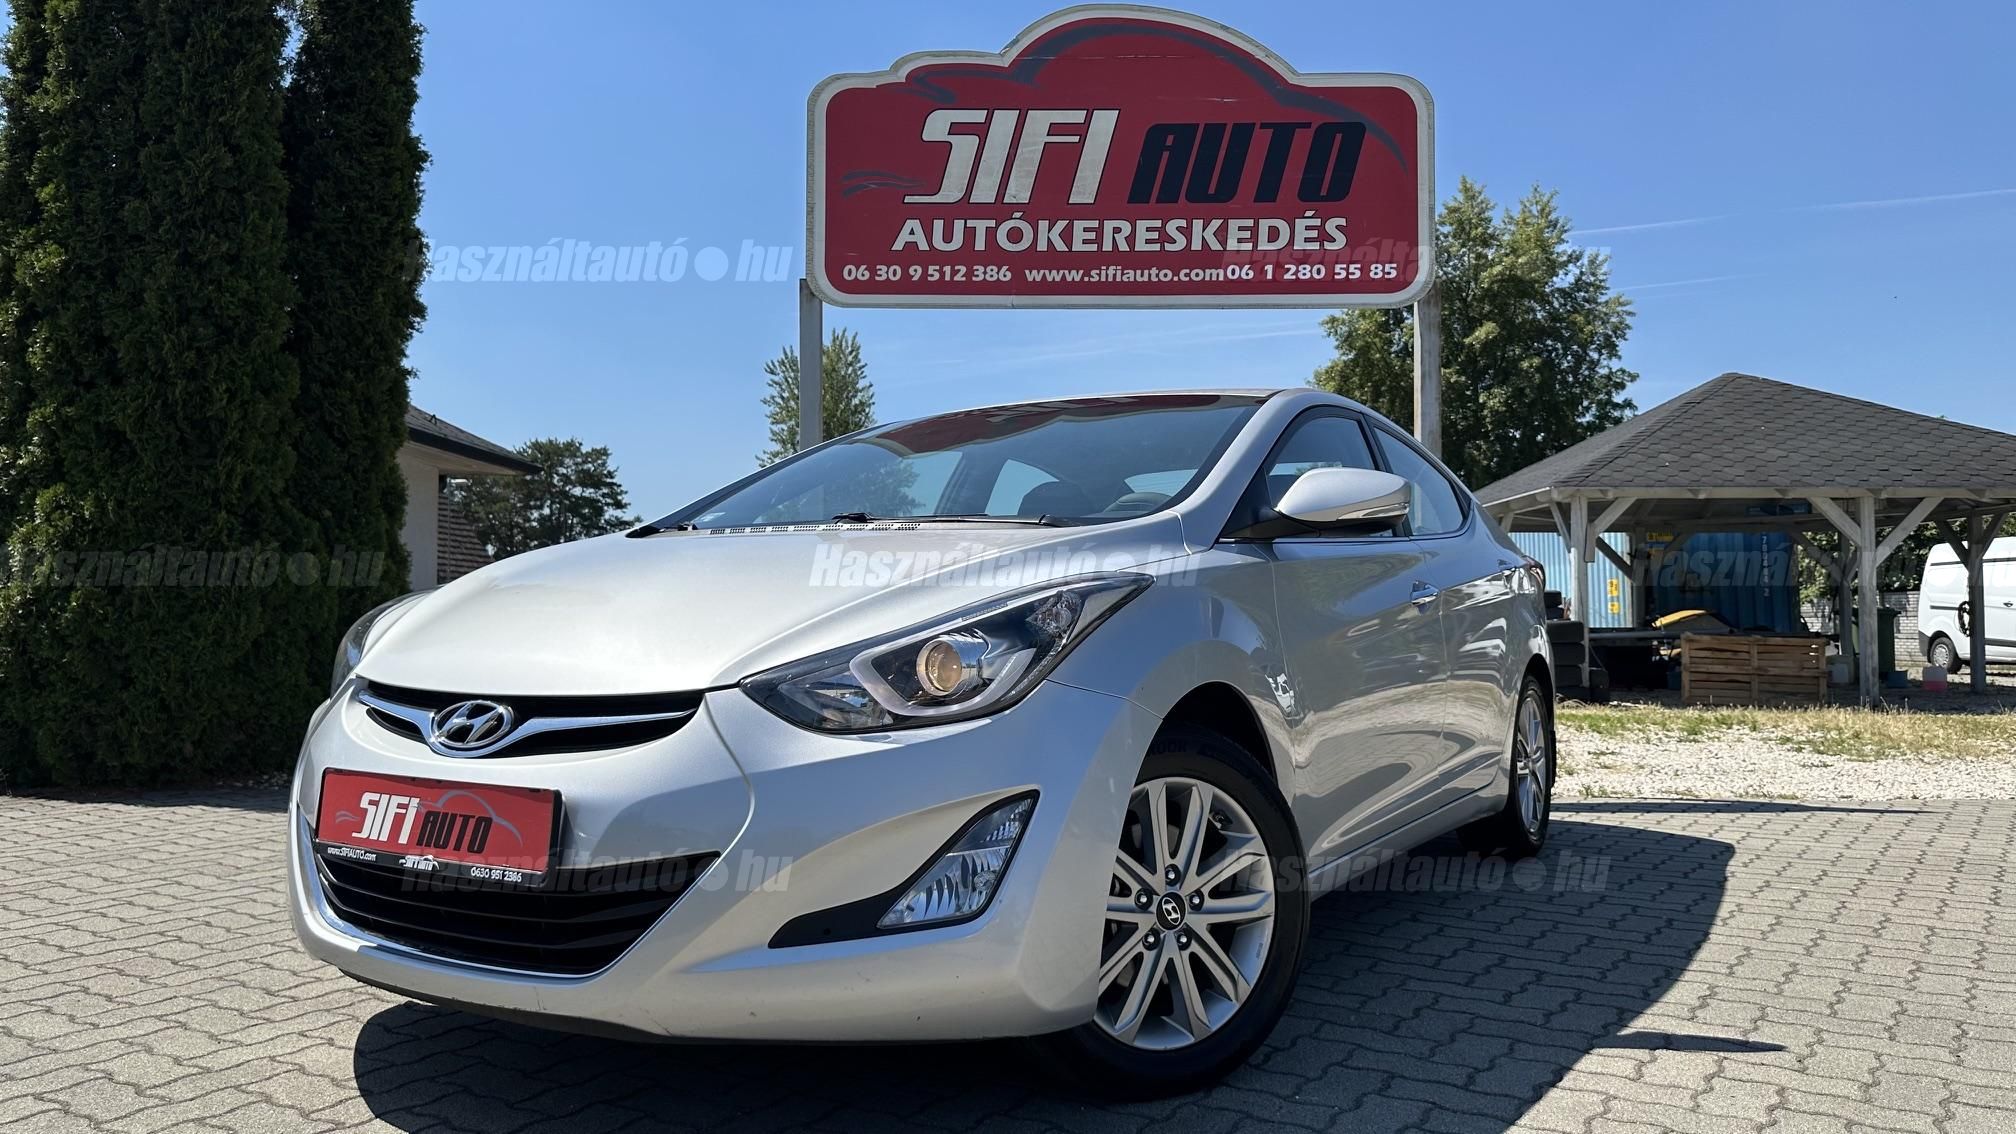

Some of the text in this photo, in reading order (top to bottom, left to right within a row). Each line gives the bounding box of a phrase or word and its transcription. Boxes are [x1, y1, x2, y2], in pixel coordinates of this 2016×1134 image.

[903, 108, 1367, 205] SIFI AUTO
[891, 211, 1348, 252] AUTÓKERESKEDÉS
[843, 264, 870, 281] 06
[875, 264, 902, 281] 30
[972, 265, 1012, 282] 386
[1025, 265, 1225, 282] www.sifiauto.com
[1226, 264, 1254, 280] 06
[1264, 264, 1274, 280] 1
[1283, 264, 1326, 280] 280
[1334, 263, 1361, 279] 55
[1369, 263, 1398, 279] 85
[352, 791, 493, 854] SIFI AUTO
[470, 866, 522, 882] 0630 951 2386
